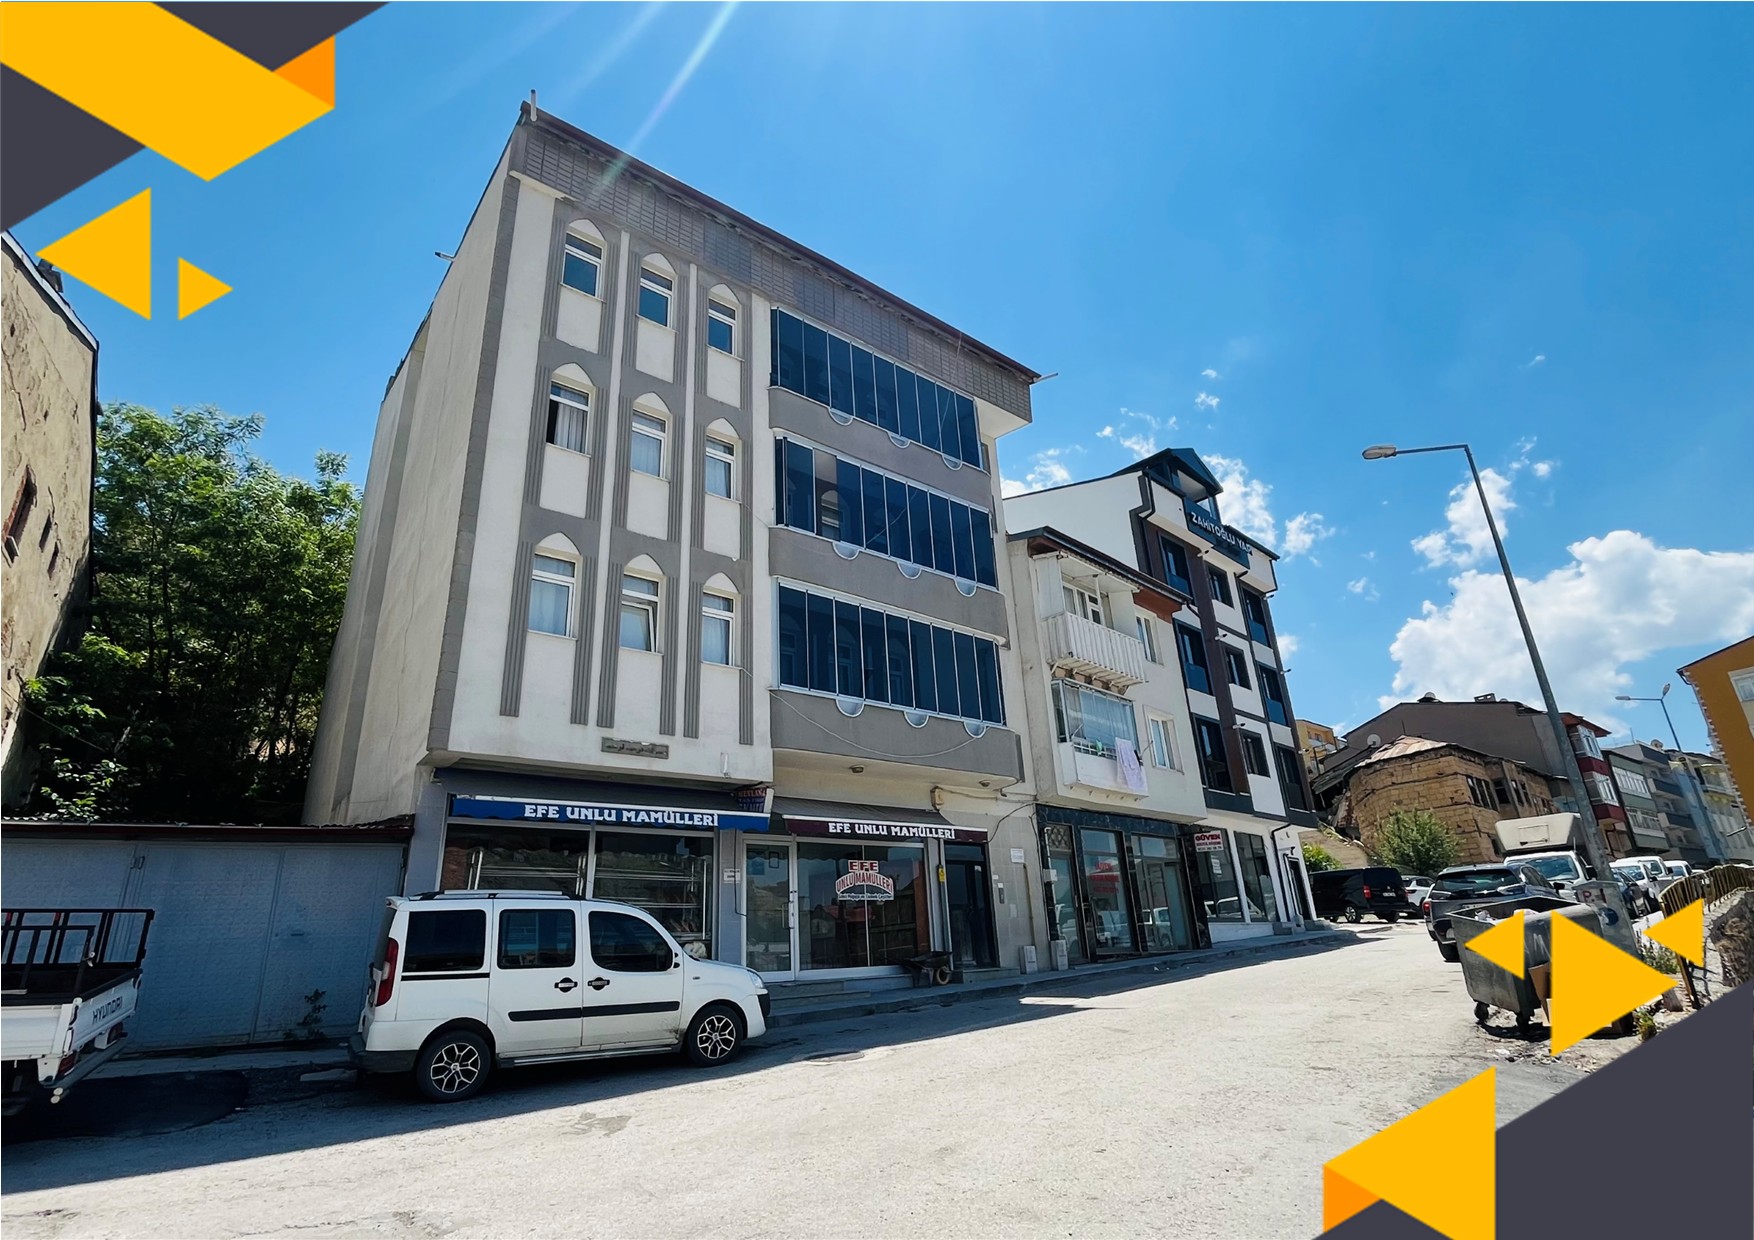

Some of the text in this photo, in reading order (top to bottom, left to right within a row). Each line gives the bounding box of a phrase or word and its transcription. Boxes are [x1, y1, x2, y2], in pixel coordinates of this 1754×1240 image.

[524, 804, 719, 826] EFE UNLU MAMÜLLERİ
[828, 822, 955, 839] EFE UNLU MAMÜLLERİ
[849, 860, 879, 872] EFE
[92, 996, 123, 1025] HYUNDAI
